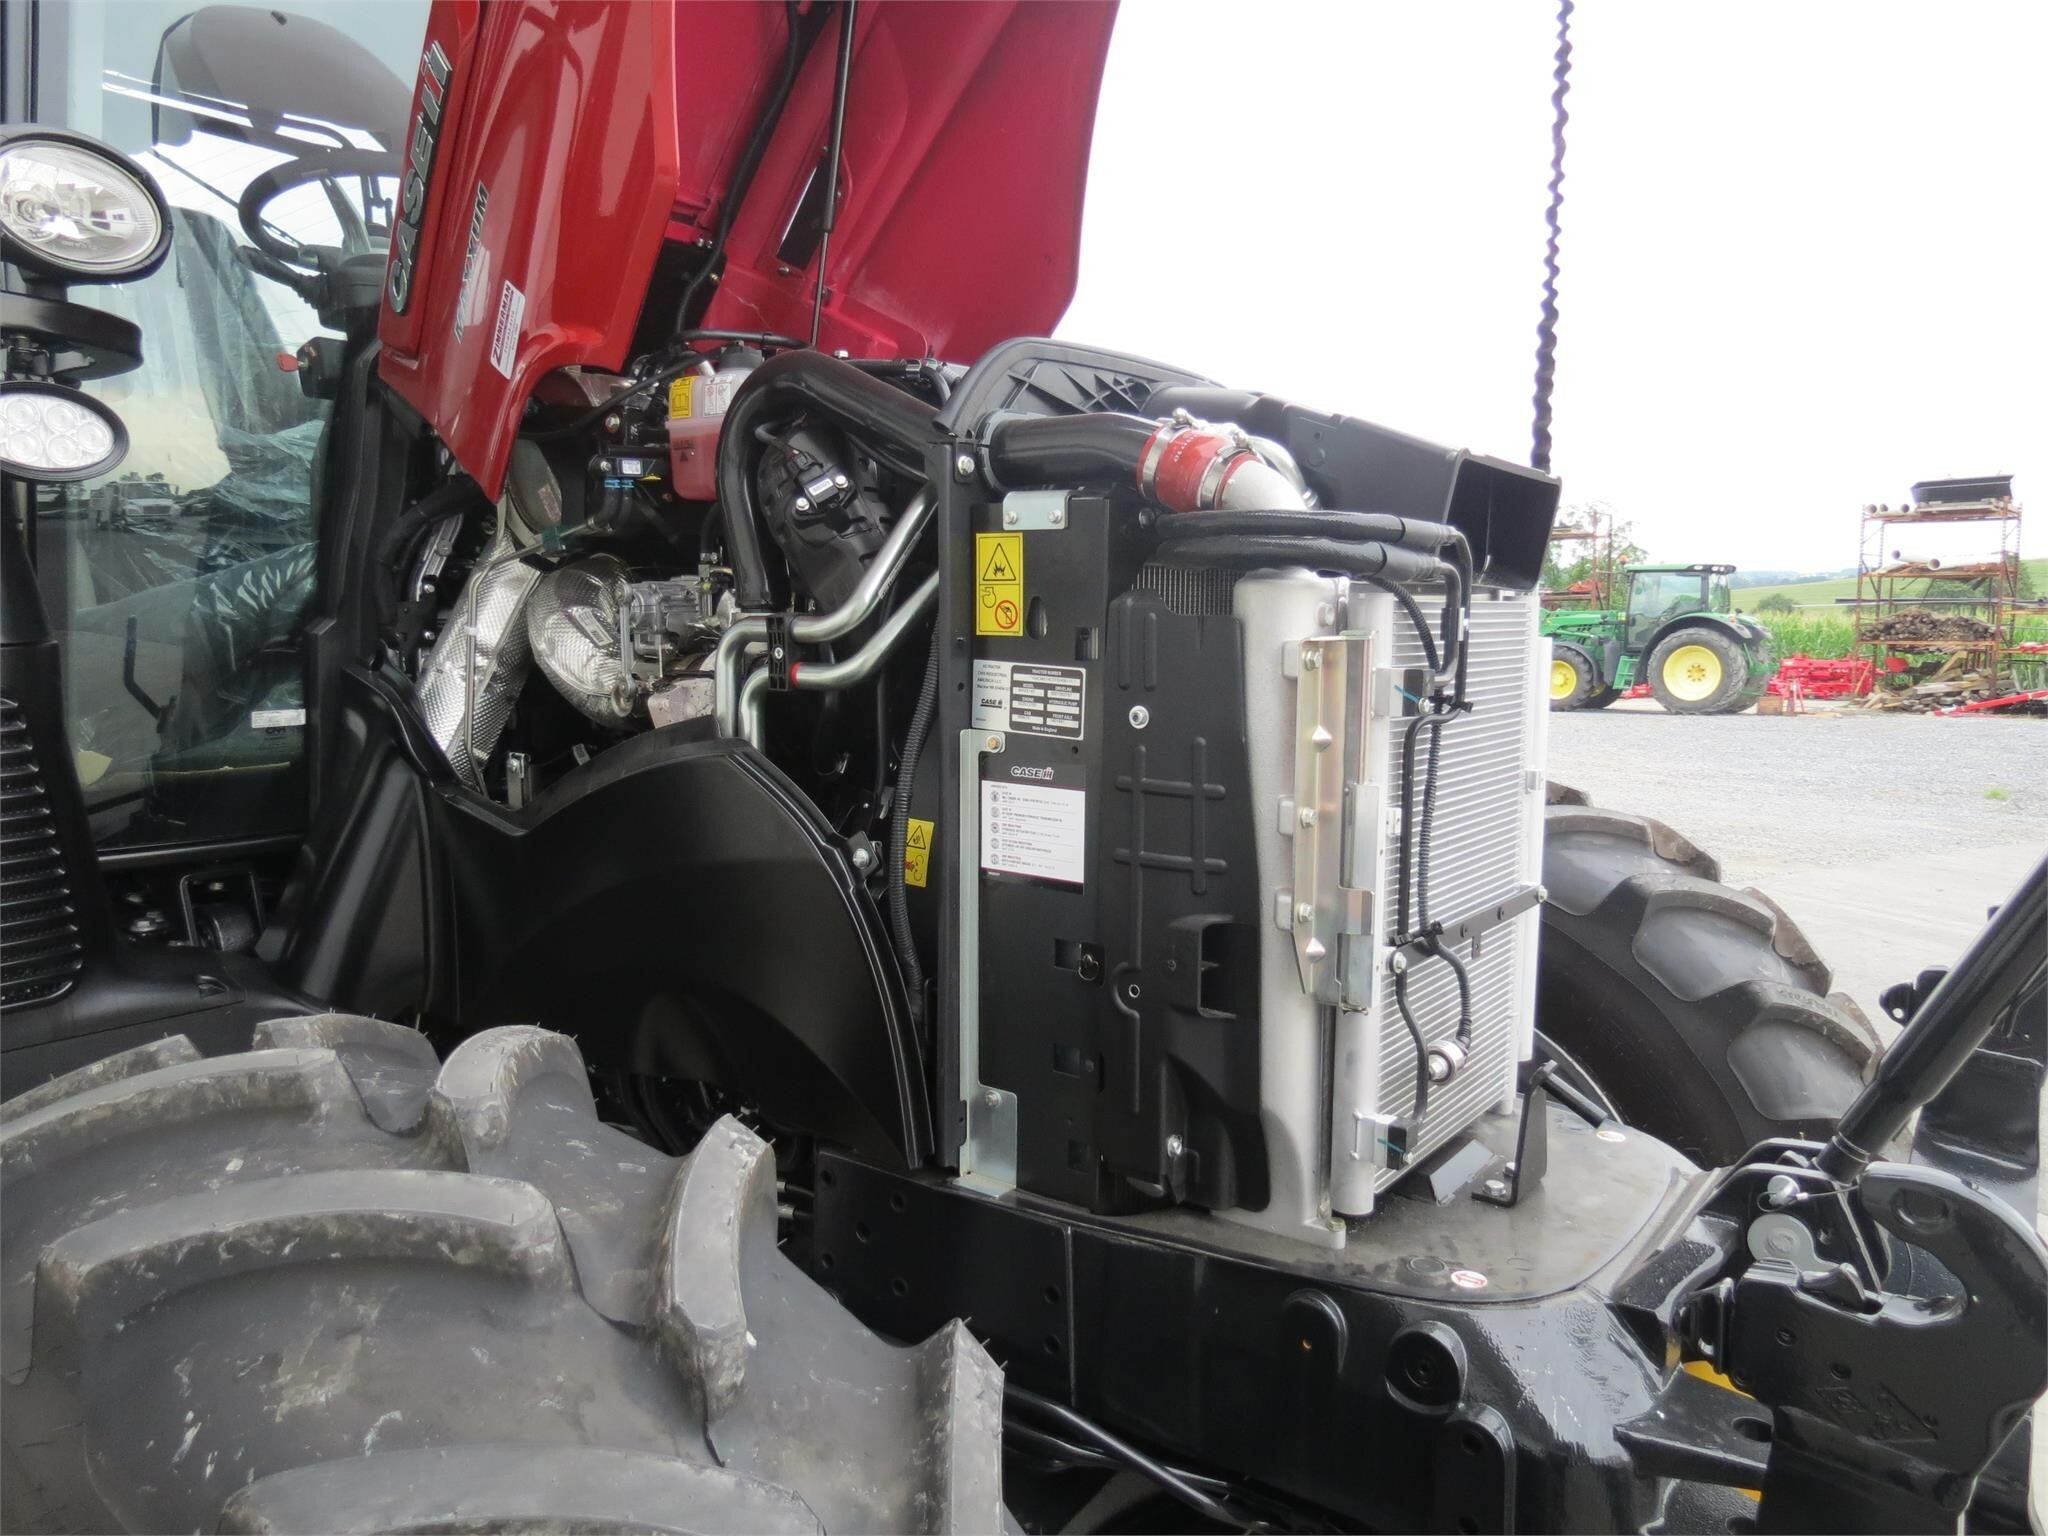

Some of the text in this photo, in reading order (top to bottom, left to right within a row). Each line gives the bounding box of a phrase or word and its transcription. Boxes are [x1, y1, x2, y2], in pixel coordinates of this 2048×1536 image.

[388, 113, 434, 313] CASE
[492, 284, 512, 367] ZIMMERMAN
[1011, 766, 1042, 779] CASE
